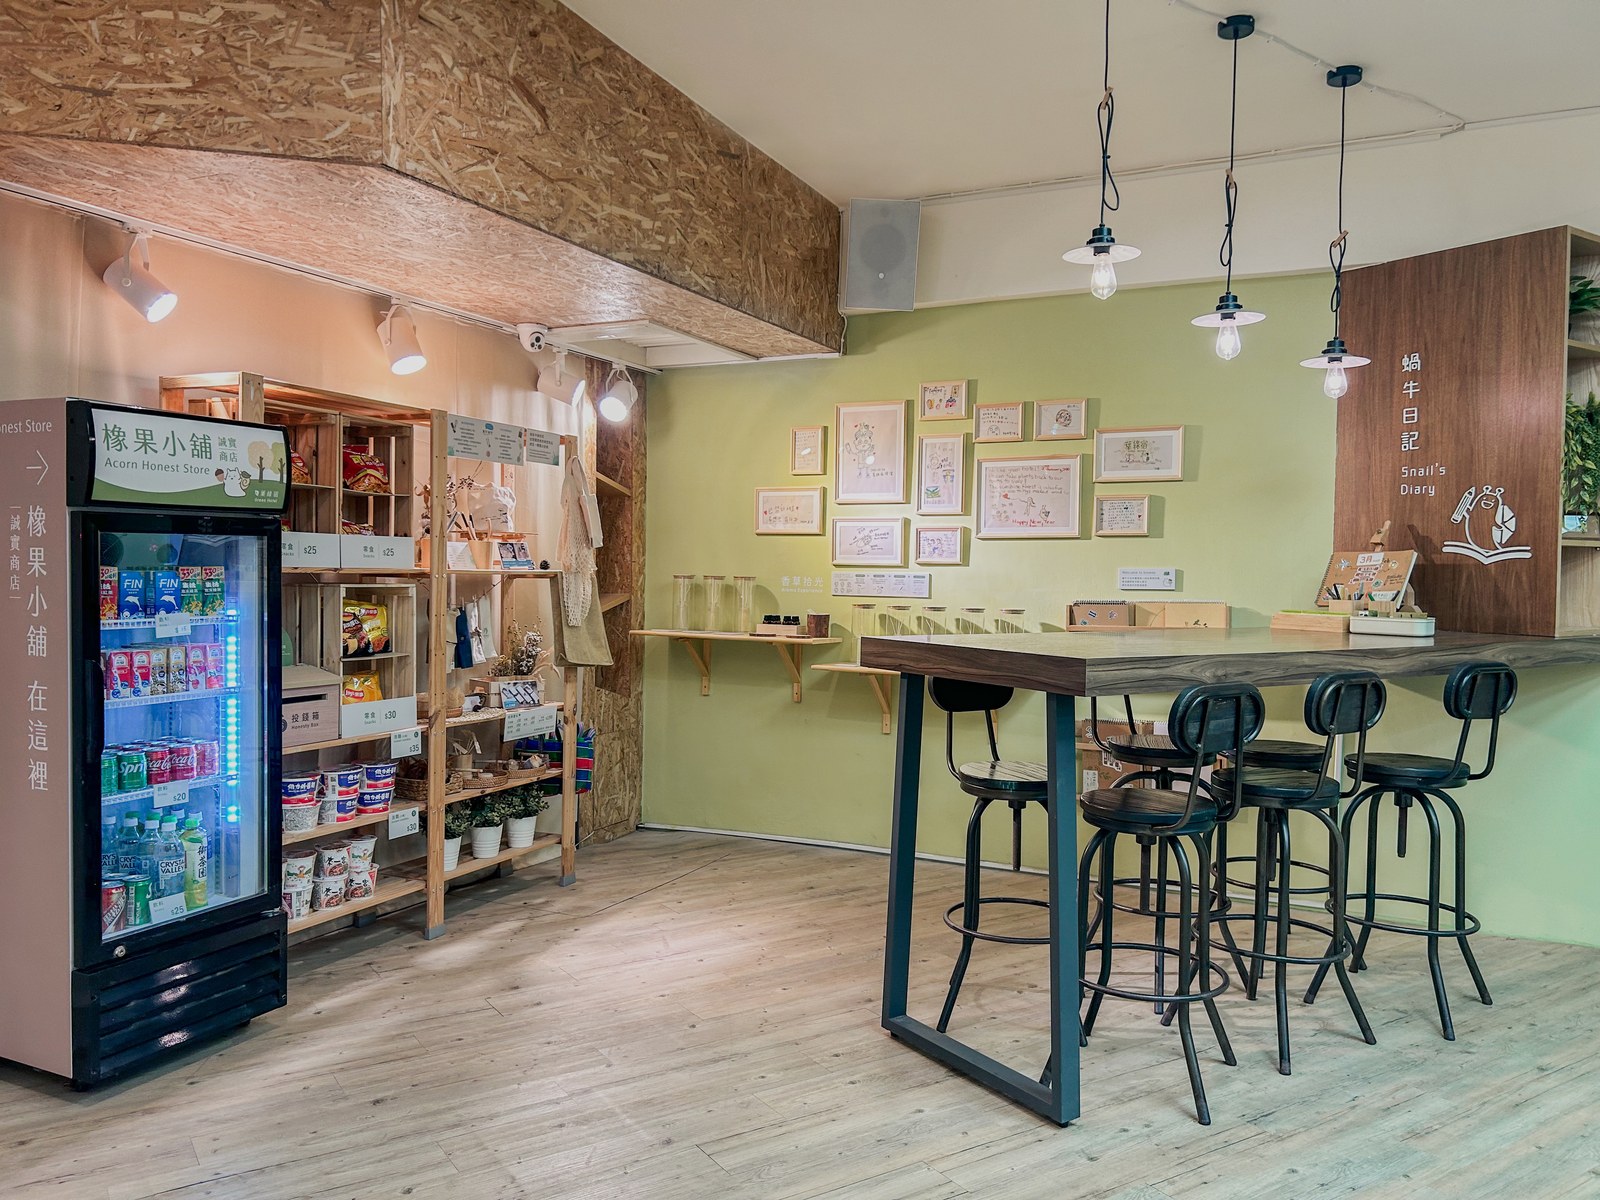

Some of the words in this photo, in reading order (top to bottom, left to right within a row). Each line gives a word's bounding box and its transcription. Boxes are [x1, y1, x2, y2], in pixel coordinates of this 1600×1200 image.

[1401, 353, 1421, 452] 蝸牛日記
[0, 421, 22, 434] nest
[25, 419, 52, 433] Store
[102, 423, 213, 461] 橡果小舖
[217, 436, 237, 449] 誠實
[219, 450, 238, 463] 商店
[104, 457, 138, 469] Acorn
[142, 460, 180, 473] Honest
[183, 463, 210, 475] Store
[1401, 462, 1446, 478] Snail's
[1400, 483, 1436, 497] Diary
[9, 514, 22, 590] 誠實商店
[303, 545, 317, 555] $25
[382, 547, 395, 557] $25
[26, 504, 48, 657] 橡果小舖
[124, 579, 143, 589] FIN
[159, 578, 179, 588] FIN
[384, 710, 397, 720] $30
[27, 680, 49, 791] 在這裡
[409, 744, 420, 753] $35
[173, 792, 187, 801] $20
[170, 905, 185, 916] $25
